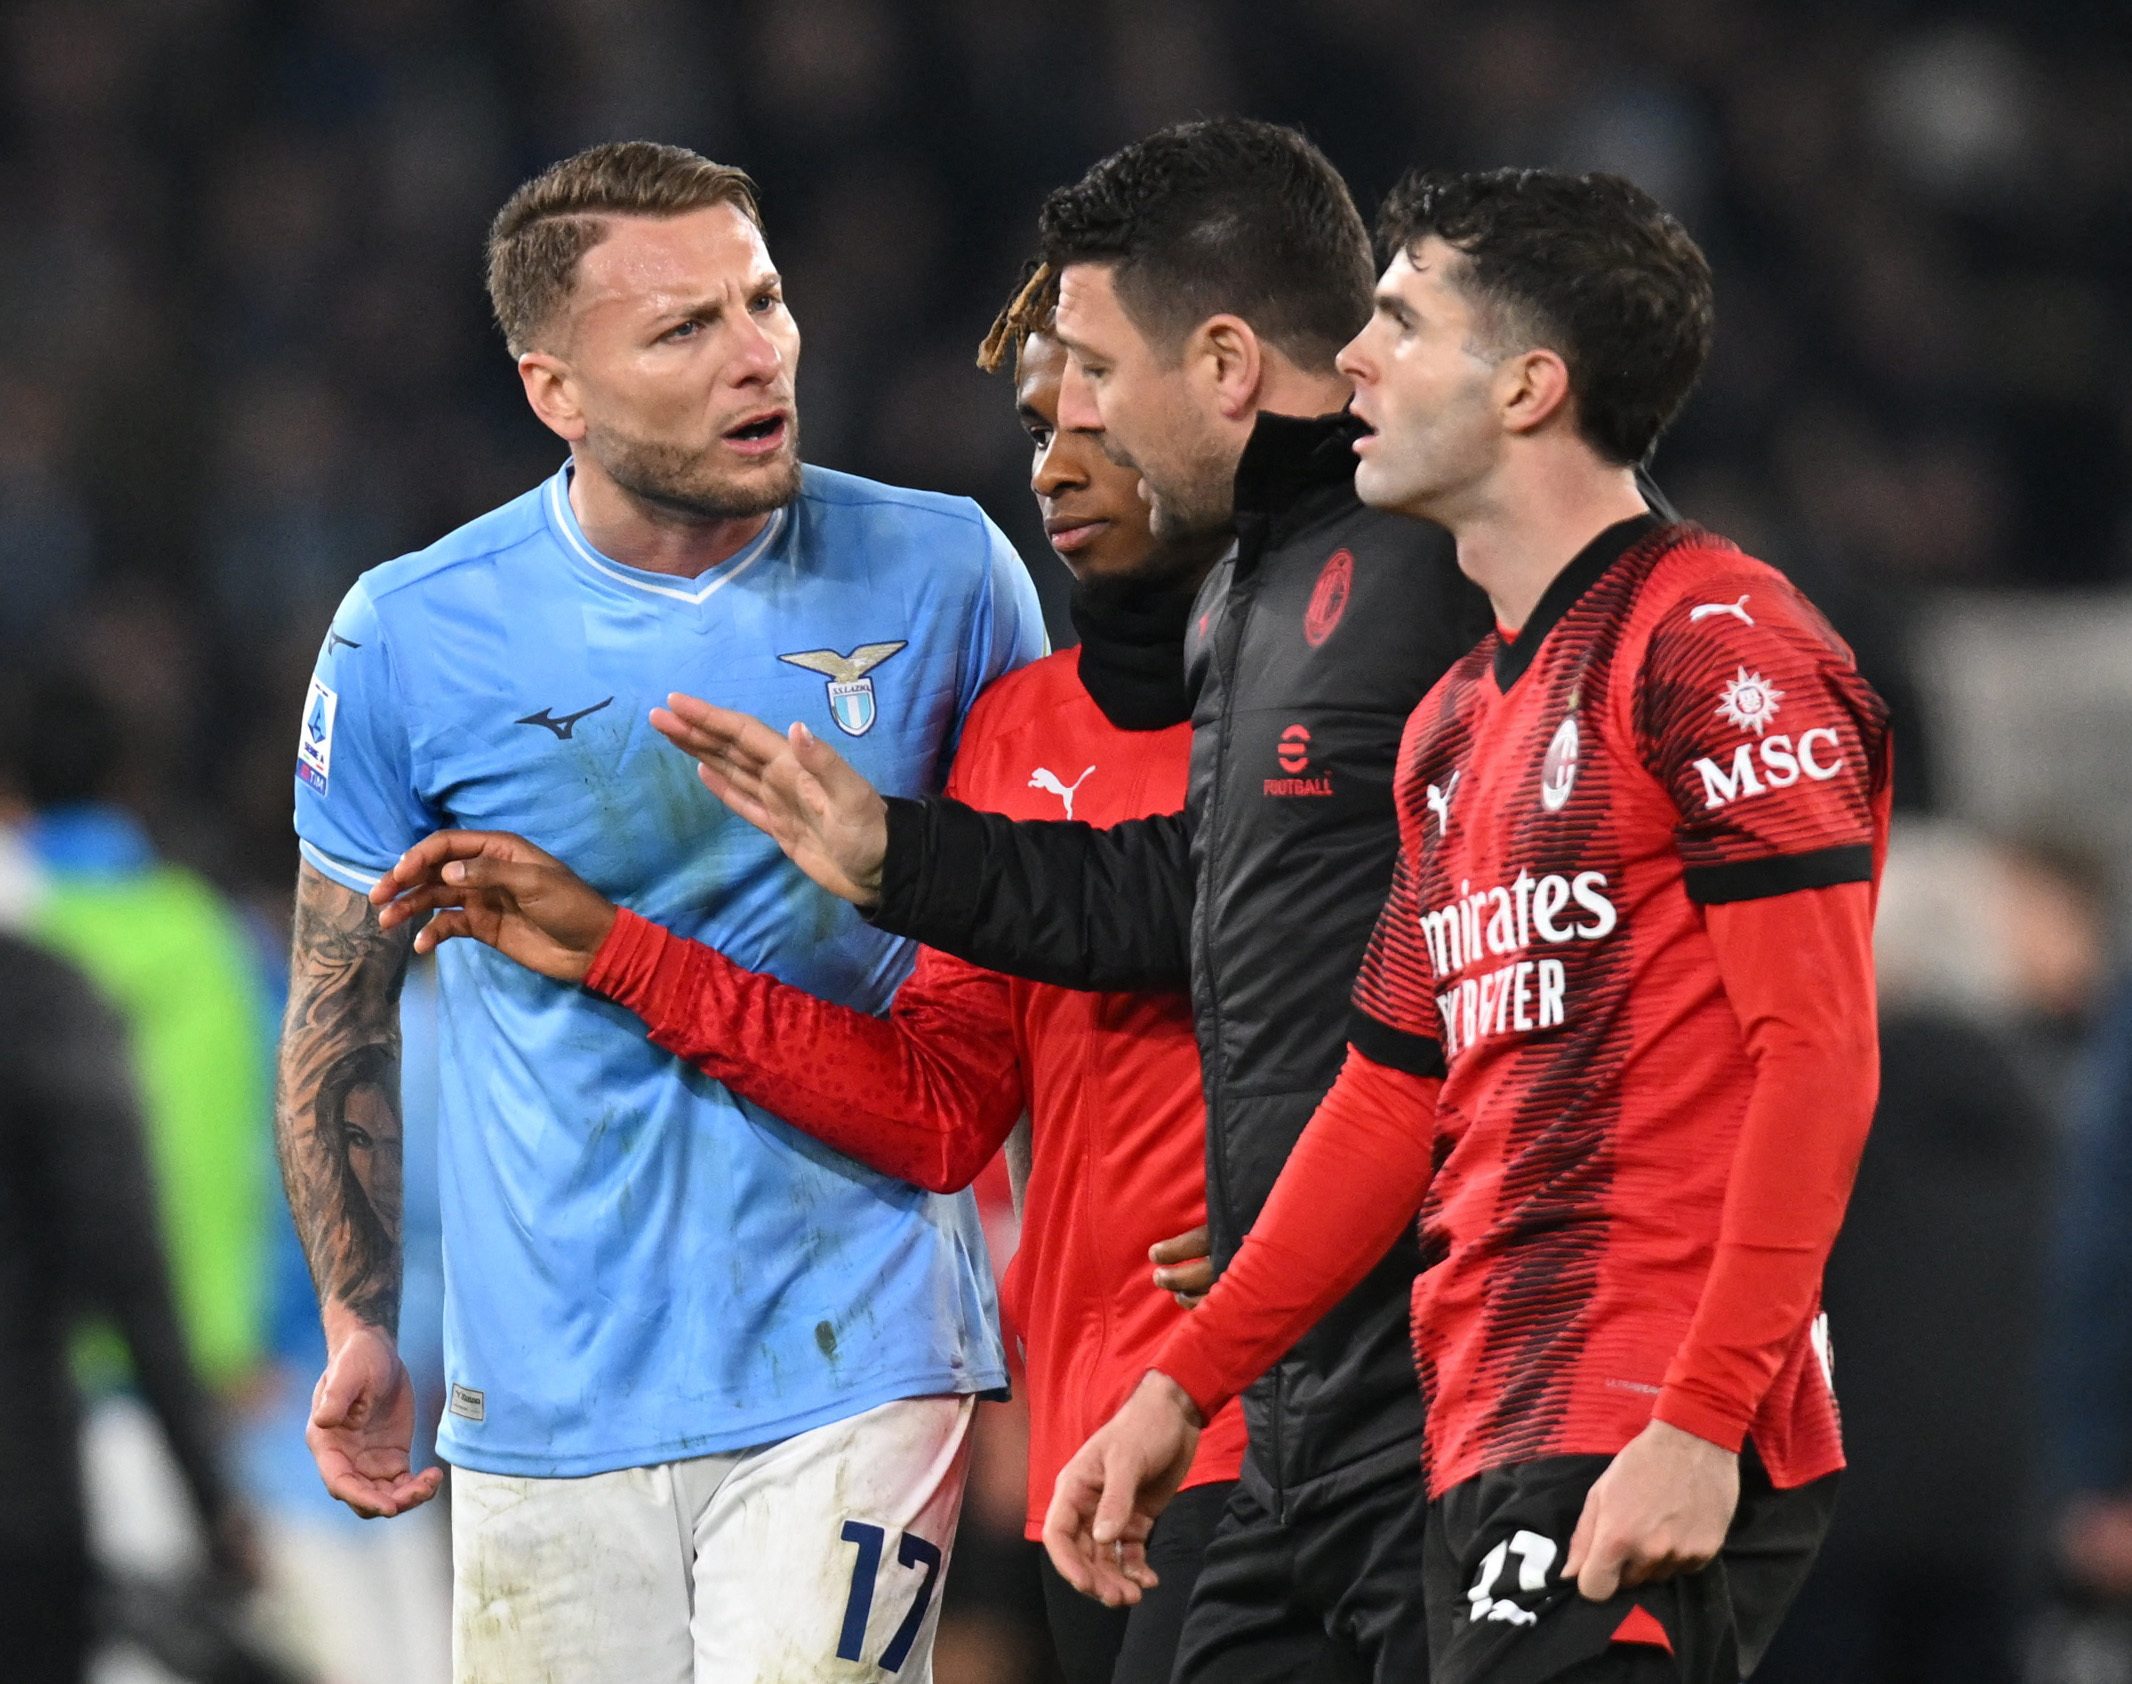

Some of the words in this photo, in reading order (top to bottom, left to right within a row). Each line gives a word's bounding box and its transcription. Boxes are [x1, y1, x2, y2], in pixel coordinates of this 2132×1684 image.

[310, 769, 325, 791] TIM
[1263, 778, 1334, 797] FOOTBALL
[1693, 728, 1843, 810] MSC
[1418, 866, 1617, 979] mirates
[836, 1519, 942, 1673] 17
